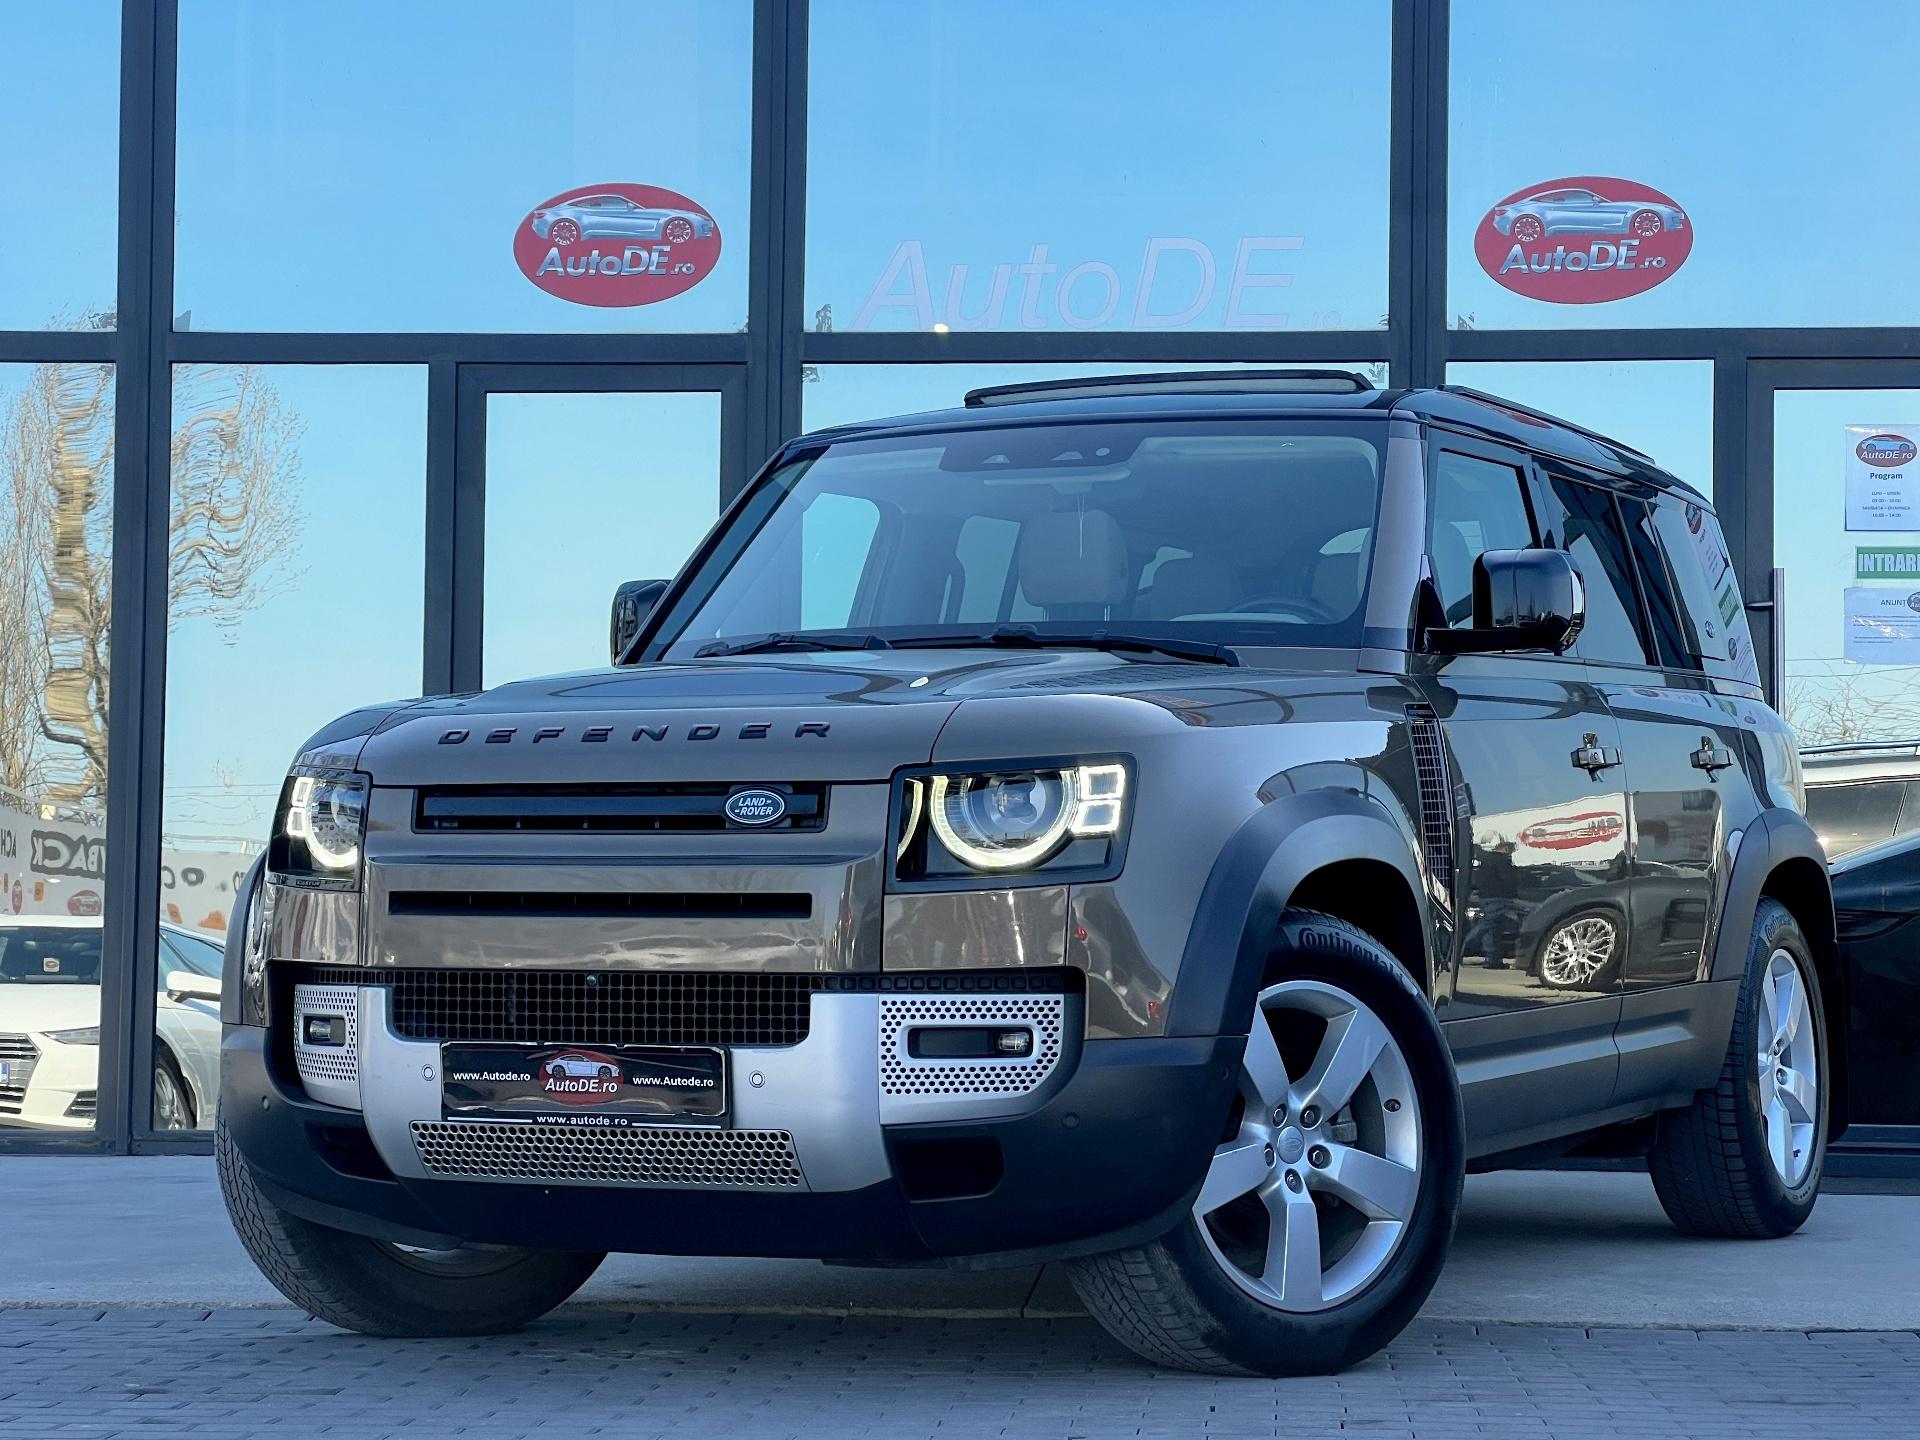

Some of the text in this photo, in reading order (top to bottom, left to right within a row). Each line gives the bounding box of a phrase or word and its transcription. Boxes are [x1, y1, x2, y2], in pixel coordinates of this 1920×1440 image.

[1860, 450, 1913, 459] AutoDE.ro
[1869, 472, 1903, 480] Program
[437, 721, 831, 745] DEFENDER
[453, 1071, 531, 1082] www.Autode.ro
[632, 1075, 714, 1087] www.Autode.ro
[545, 1078, 619, 1093] AutoDE.ro
[536, 1114, 628, 1127] www.autode.ro
